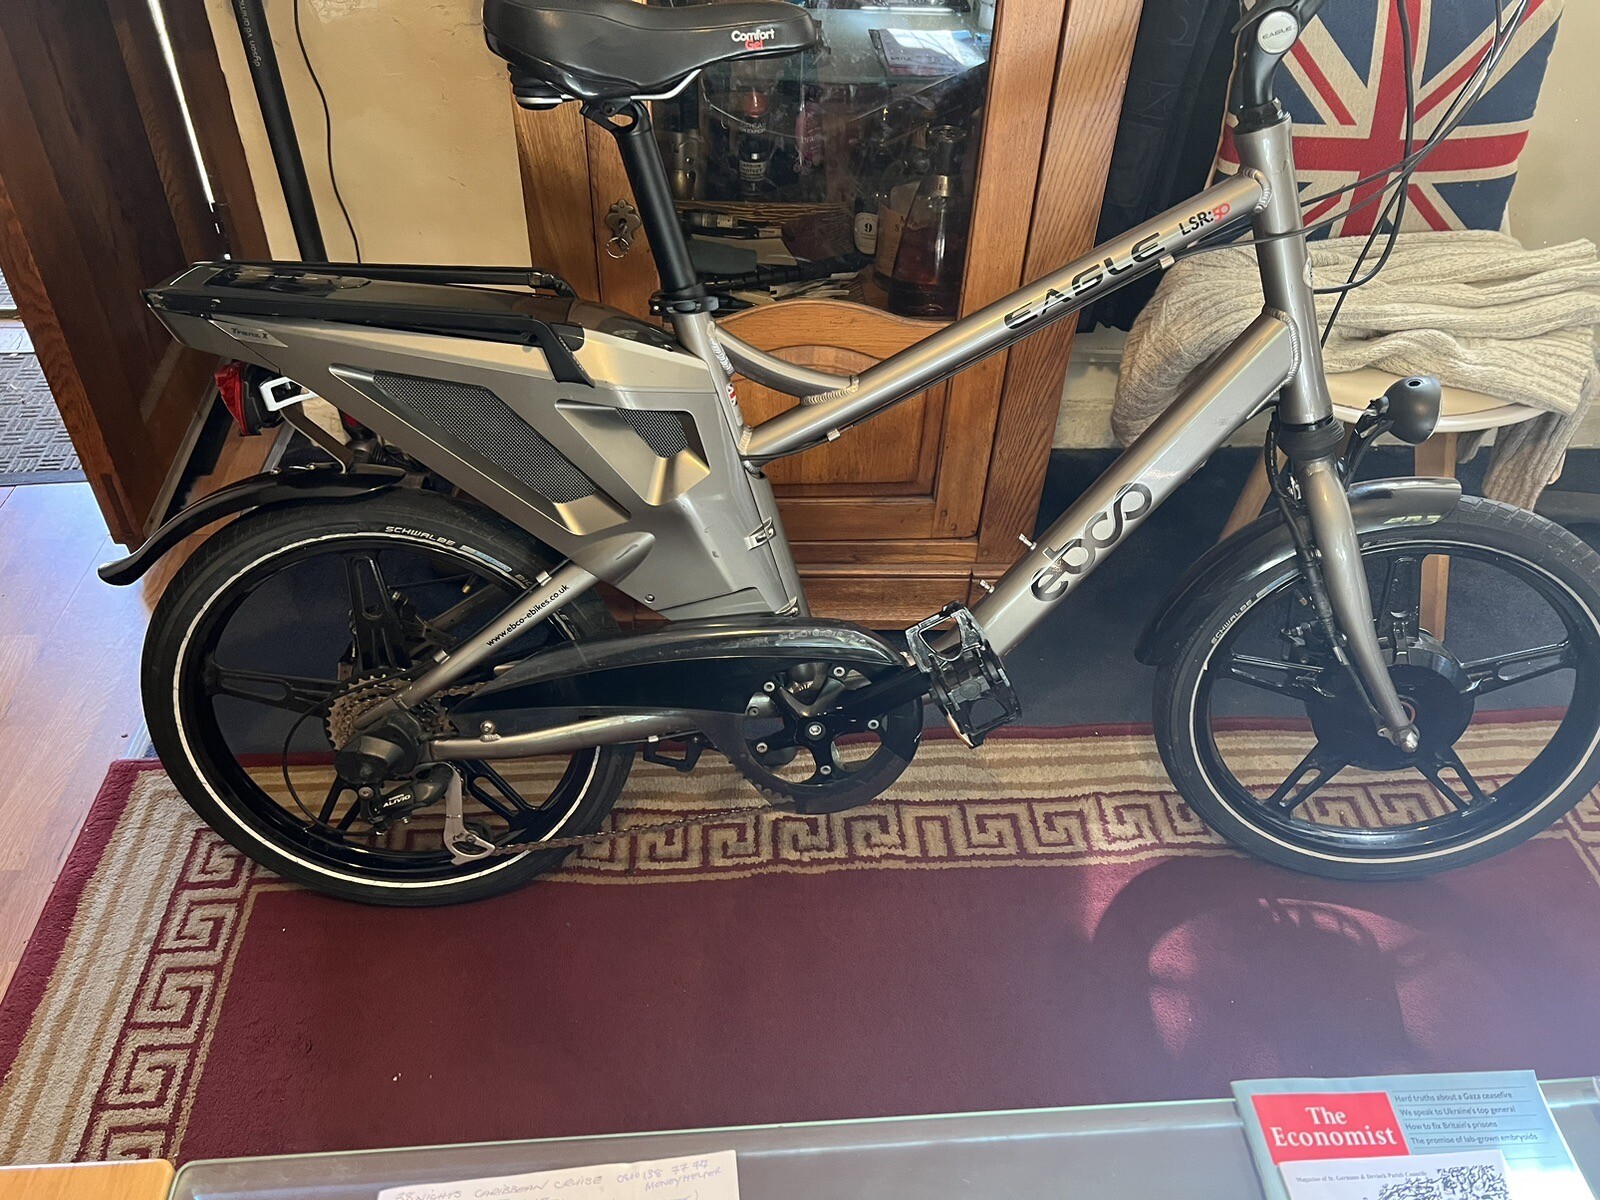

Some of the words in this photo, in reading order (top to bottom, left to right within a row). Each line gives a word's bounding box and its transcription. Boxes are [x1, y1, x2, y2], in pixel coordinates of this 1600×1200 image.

[731, 28, 775, 42] Comfort
[1262, 25, 1293, 39] EAGLE
[745, 40, 763, 50] Gel
[250, 41, 262, 67] dyson
[864, 222, 873, 233] 9
[1004, 232, 1166, 330] EAGLE
[1179, 202, 1231, 236] LSR:50
[385, 525, 456, 546] SCHWALBE
[1030, 482, 1153, 602] ebco
[486, 583, 570, 647] www.ebco-ebikes.co.uk
[1210, 598, 1252, 645] SCHWALBE
[382, 794, 411, 808] ALIVIO
[1436, 1093, 1457, 1101] about
[1463, 1092, 1481, 1100] Gaza
[1482, 1091, 1513, 1100] ceasefire
[1305, 1106, 1347, 1125] The
[1413, 1109, 1434, 1118] speak
[1443, 1107, 1476, 1115] Ukraine's
[1476, 1107, 1490, 1115] top
[1490, 1105, 1516, 1115] general
[1405, 1122, 1421, 1130] How
[1422, 1122, 1431, 1130] to
[1431, 1121, 1441, 1129] fix
[1442, 1121, 1471, 1129] Britain's
[1472, 1121, 1498, 1130] prisons
[1269, 1125, 1398, 1147] Economist
[1426, 1137, 1455, 1146] promise
[1463, 1134, 1499, 1145] lab-grown
[1500, 1132, 1538, 1143] embryoids
[616, 1172, 640, 1184] 0800
[474, 1179, 549, 1198] CARIBBEAN
[554, 1175, 603, 1190] CRUISE
